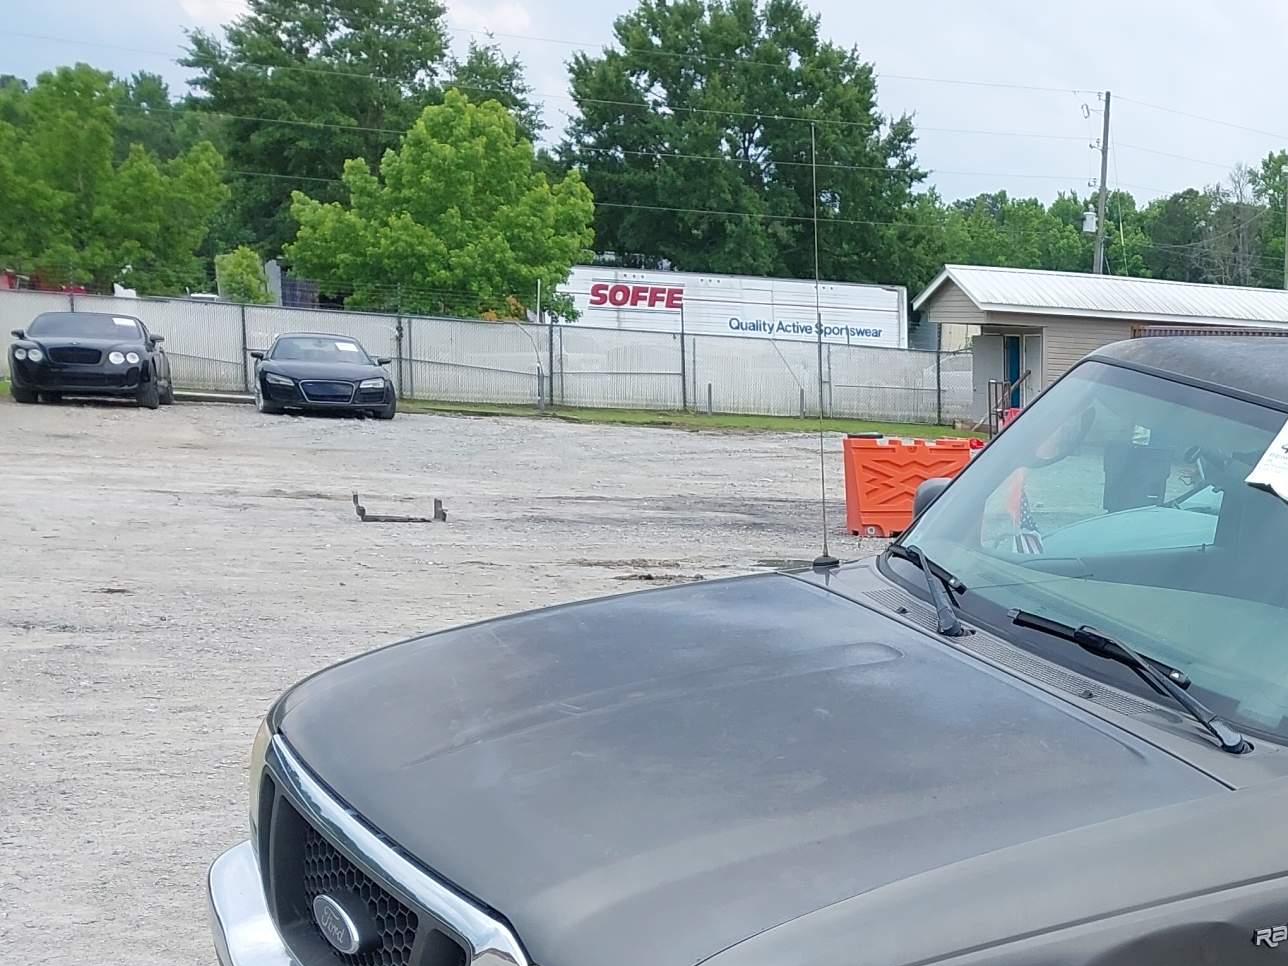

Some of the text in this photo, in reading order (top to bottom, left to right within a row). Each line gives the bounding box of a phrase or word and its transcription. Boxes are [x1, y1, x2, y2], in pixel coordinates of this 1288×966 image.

[589, 283, 683, 308] SOFFE
[728, 317, 882, 338] Quality Active Sportswear
[320, 905, 345, 945] Ford
